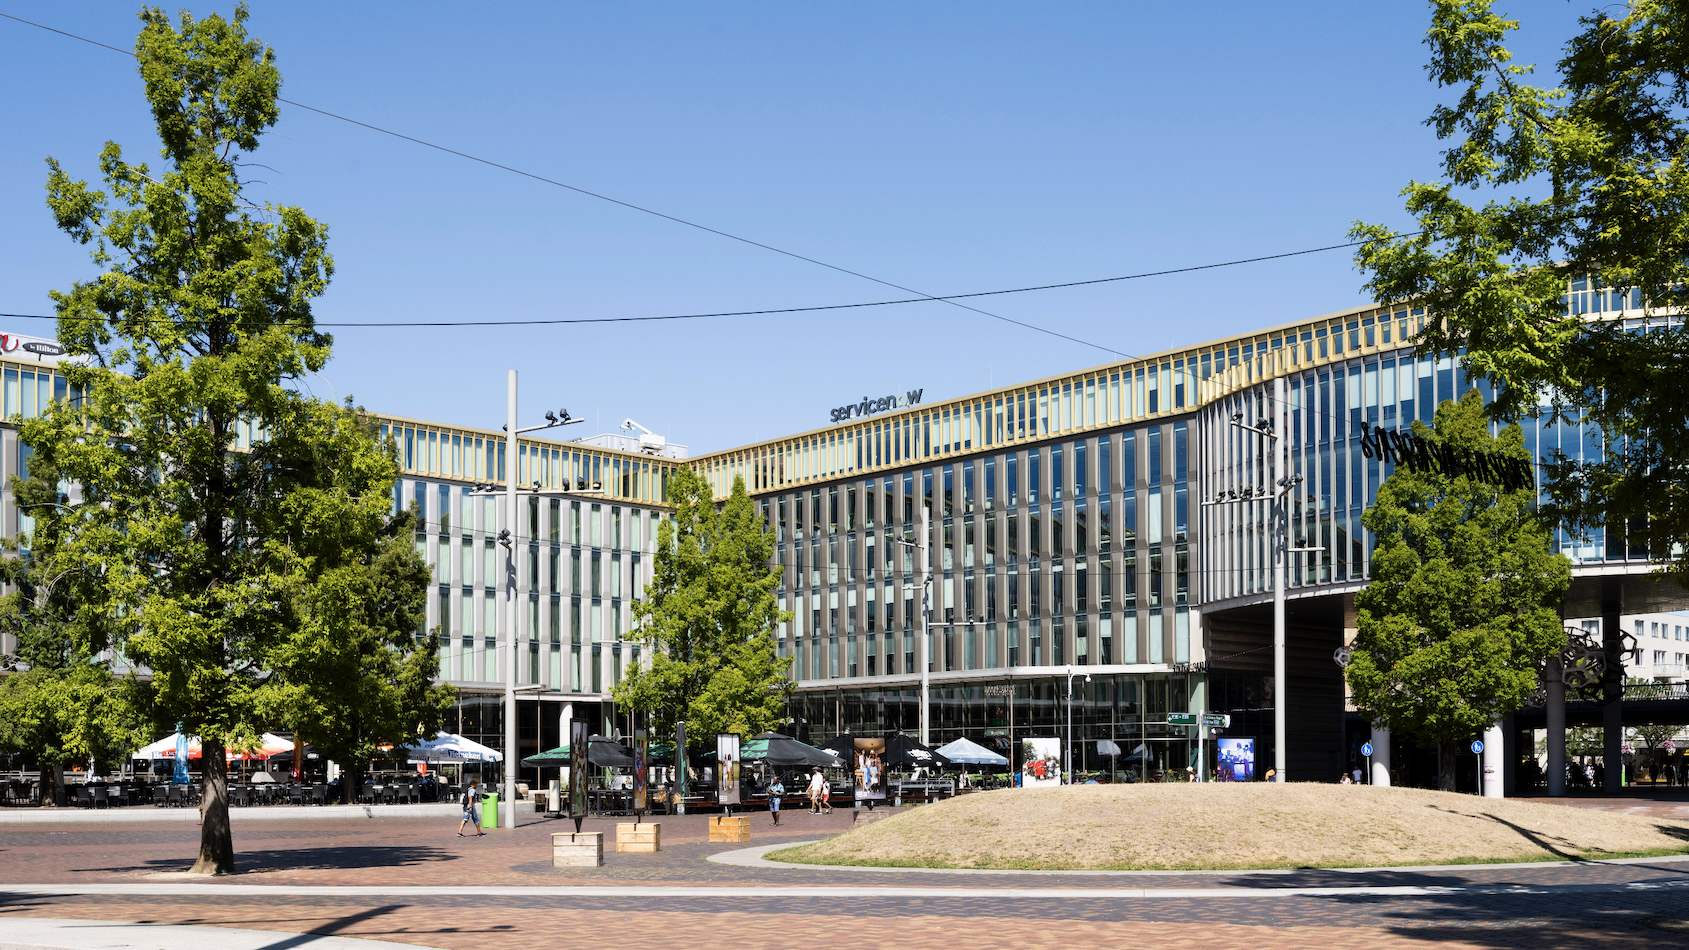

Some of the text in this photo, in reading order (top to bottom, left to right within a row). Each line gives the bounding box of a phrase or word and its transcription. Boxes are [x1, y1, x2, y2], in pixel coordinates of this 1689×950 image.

[36, 344, 59, 354] Hilton
[830, 388, 923, 422] servicenow
[449, 750, 482, 760] Heineken
